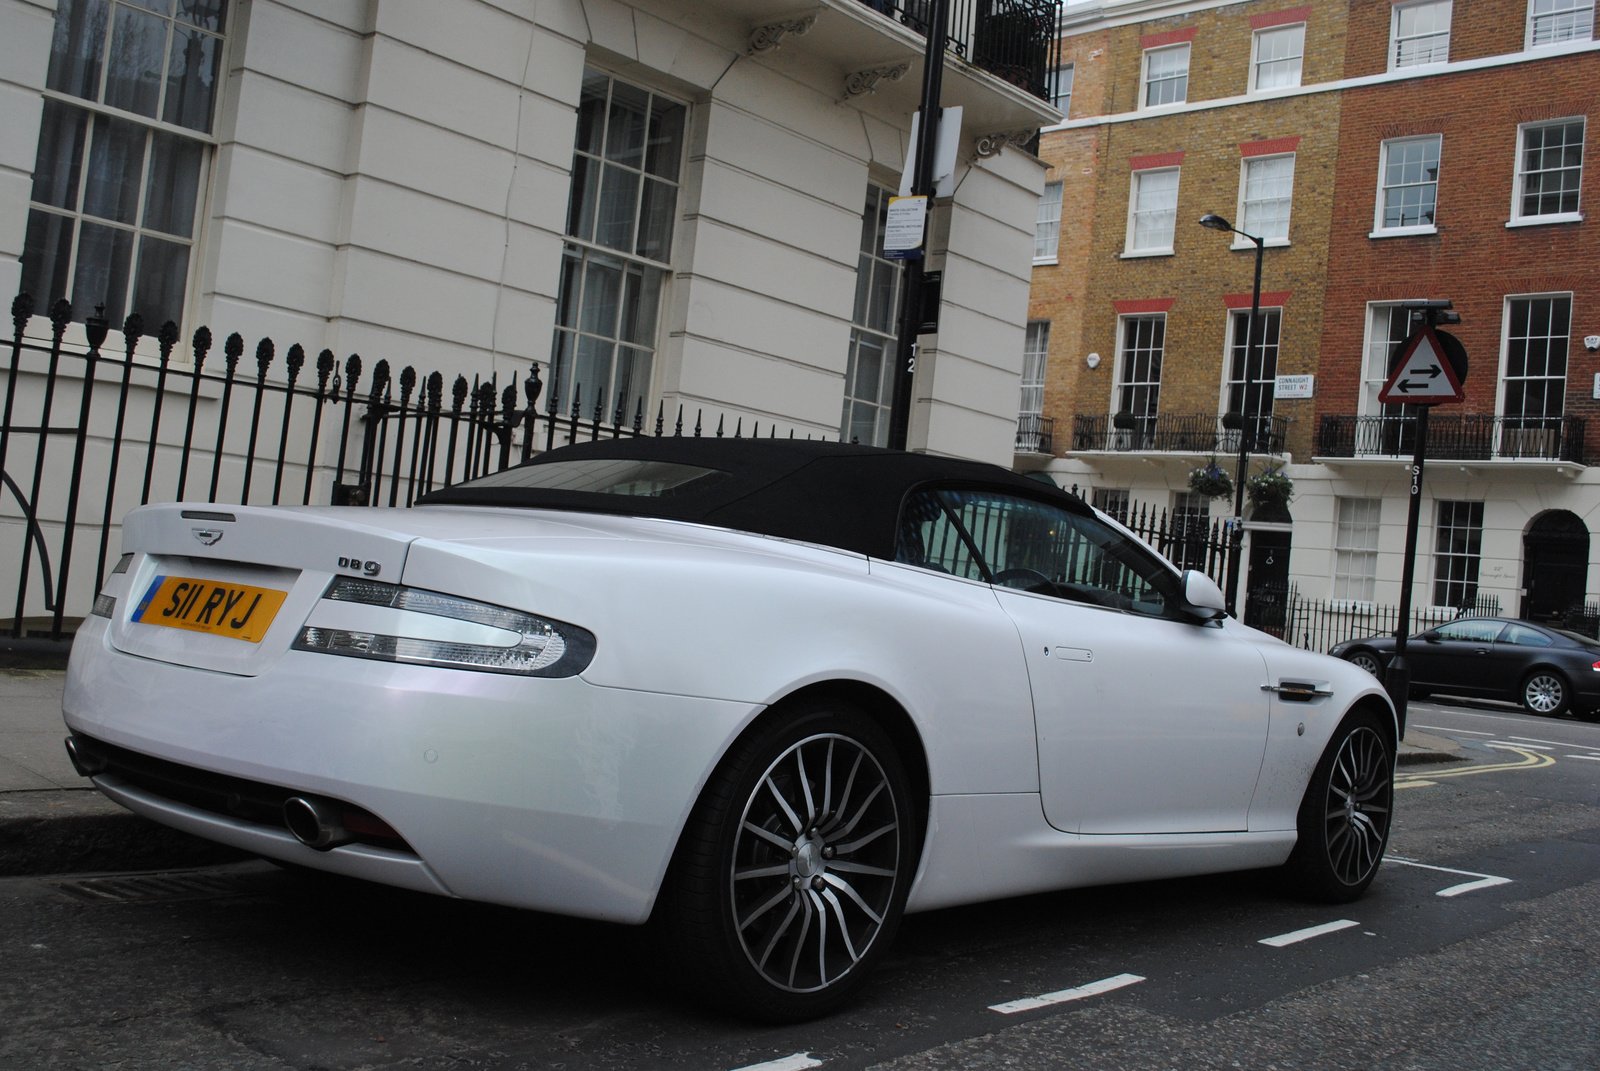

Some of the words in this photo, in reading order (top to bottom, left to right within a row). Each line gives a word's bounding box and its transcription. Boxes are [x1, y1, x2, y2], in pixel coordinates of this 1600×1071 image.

[1410, 466, 1420, 495] S10
[338, 556, 382, 576] DB9
[196, 587, 262, 629] RYJ
